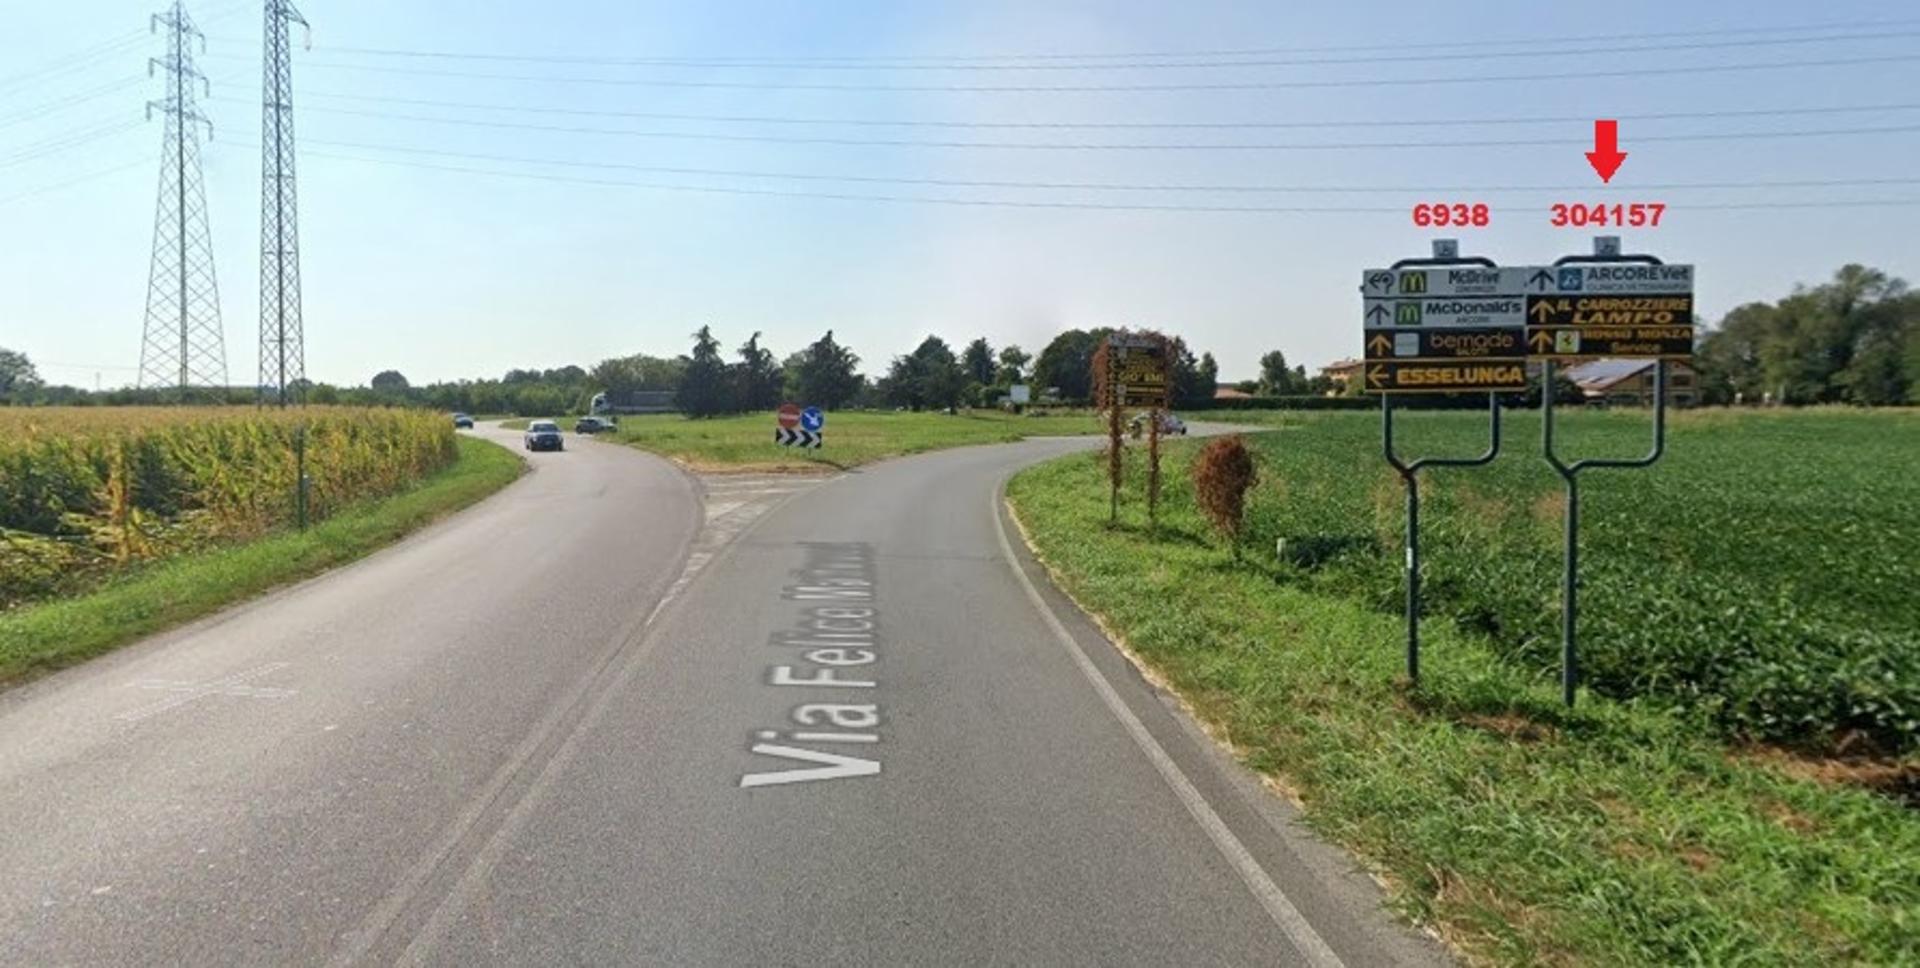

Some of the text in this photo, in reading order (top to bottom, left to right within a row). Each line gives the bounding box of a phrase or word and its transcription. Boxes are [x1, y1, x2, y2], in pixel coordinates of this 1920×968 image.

[1425, 302, 1522, 315] McDonald's
[1571, 311, 1674, 325] LAMPO
[1396, 365, 1524, 385] ESSELUNGA
